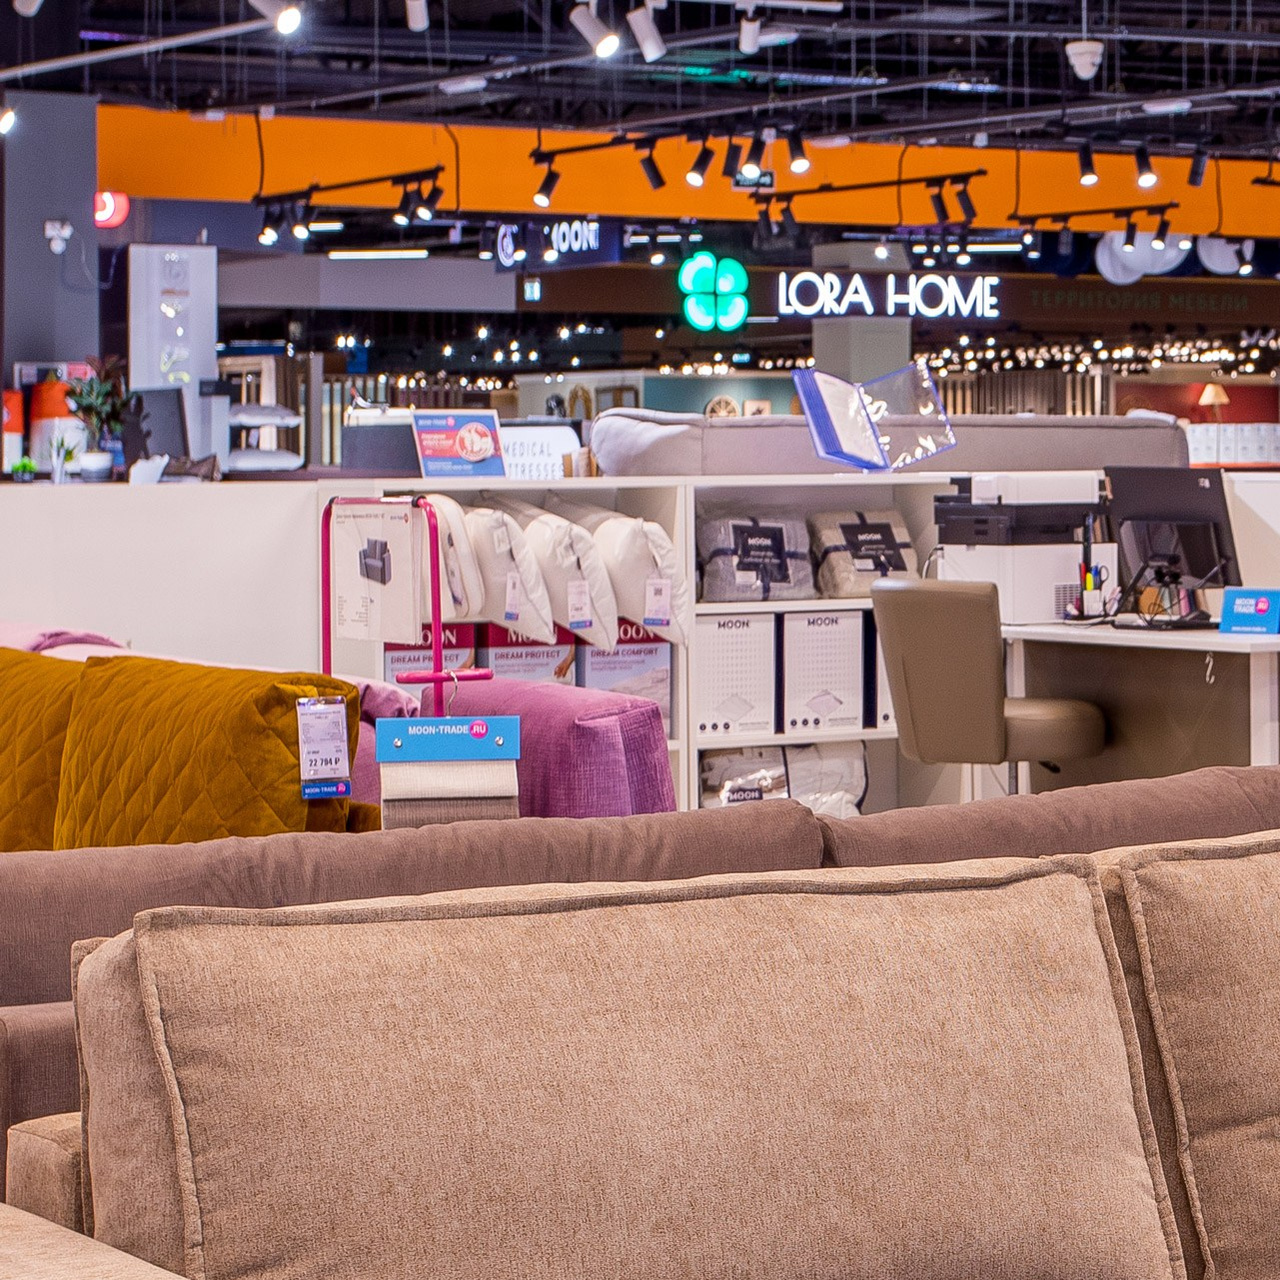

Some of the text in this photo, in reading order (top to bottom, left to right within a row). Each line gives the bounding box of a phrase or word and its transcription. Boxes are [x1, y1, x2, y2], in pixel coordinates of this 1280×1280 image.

[778, 271, 1000, 318] LORA HOME
[717, 619, 750, 629] MOON
[807, 617, 839, 627] MOON
[494, 648, 561, 661] DREAM PROTECT
